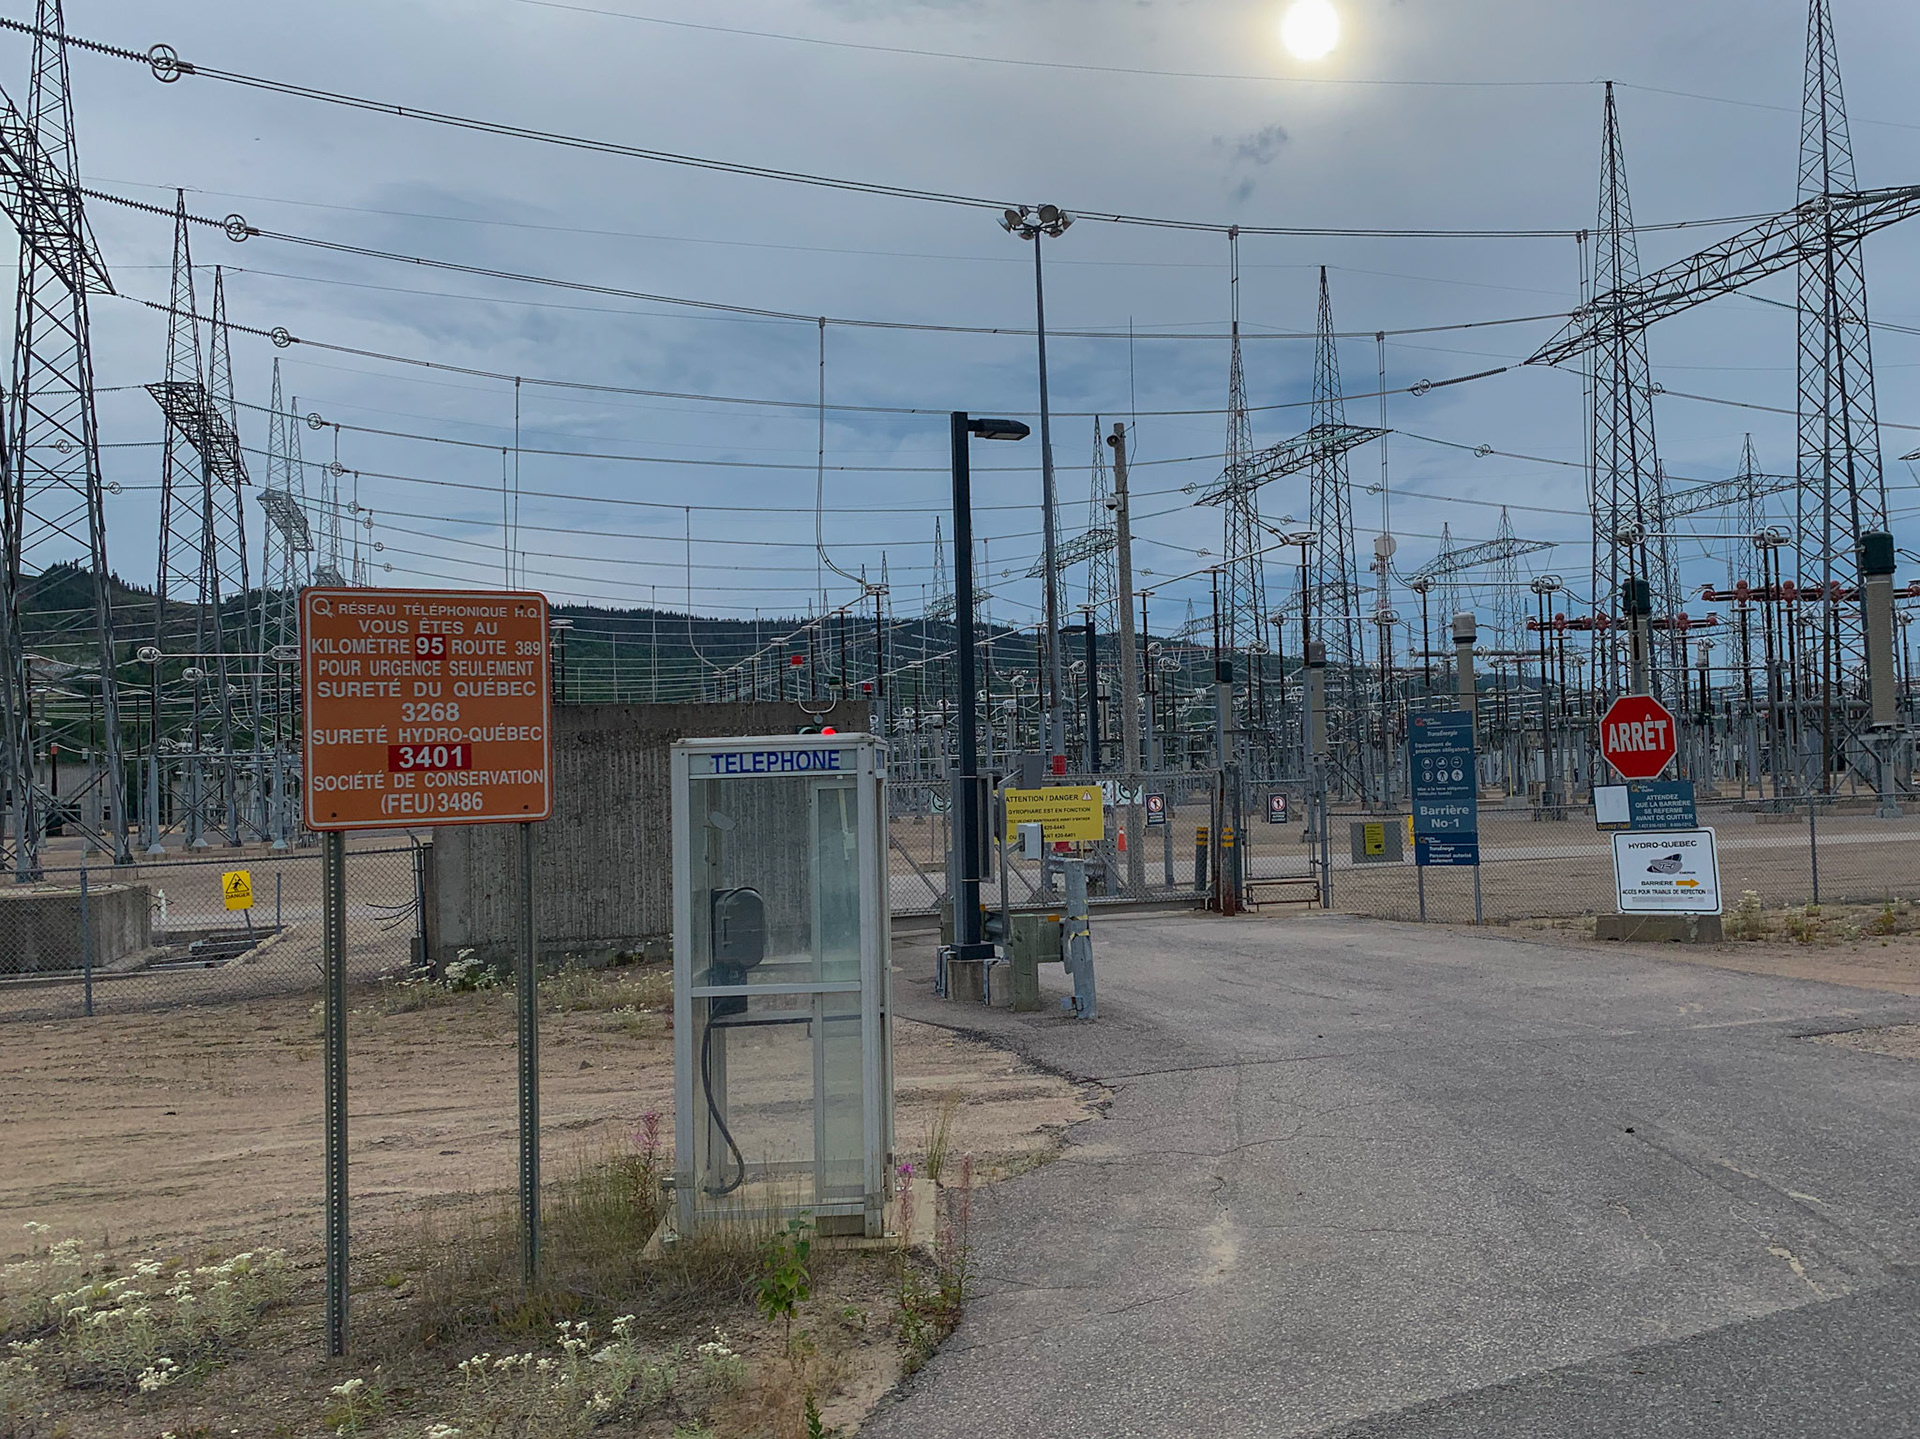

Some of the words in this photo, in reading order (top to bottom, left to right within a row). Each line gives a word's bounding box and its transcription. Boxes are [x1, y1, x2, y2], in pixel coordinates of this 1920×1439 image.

[338, 600, 397, 616] RÉSEAU
[403, 601, 508, 618] TÉLÉPHONIQUE
[514, 606, 541, 618] H.Q.
[359, 619, 409, 634] VOUS
[419, 617, 464, 635] ÊTES
[474, 622, 498, 635] AU
[311, 635, 410, 655] KILOMÈTRE
[415, 636, 445, 655] 95
[451, 639, 506, 655] ROUTE
[514, 640, 541, 656] 389
[318, 659, 362, 676] POUR
[369, 660, 442, 677] URGENCE
[449, 660, 534, 677] SEULEMENT
[317, 678, 402, 697] SURETÉ
[413, 681, 442, 697] DU
[453, 677, 537, 697] QUÉBEC
[401, 702, 460, 722] 3268
[312, 725, 388, 745] SURETÉ
[399, 722, 543, 743] HYDRO-QUÉBEC
[1608, 713, 1668, 753] ARRÊT
[398, 745, 464, 769] 3401
[711, 750, 840, 774] TELEPHONE
[313, 771, 385, 792] SOCIÉTÉ
[393, 773, 416, 788] DE
[424, 768, 544, 788] CONSERVATION
[1420, 805, 1469, 816] Barrière
[1431, 818, 1460, 828] No-1
